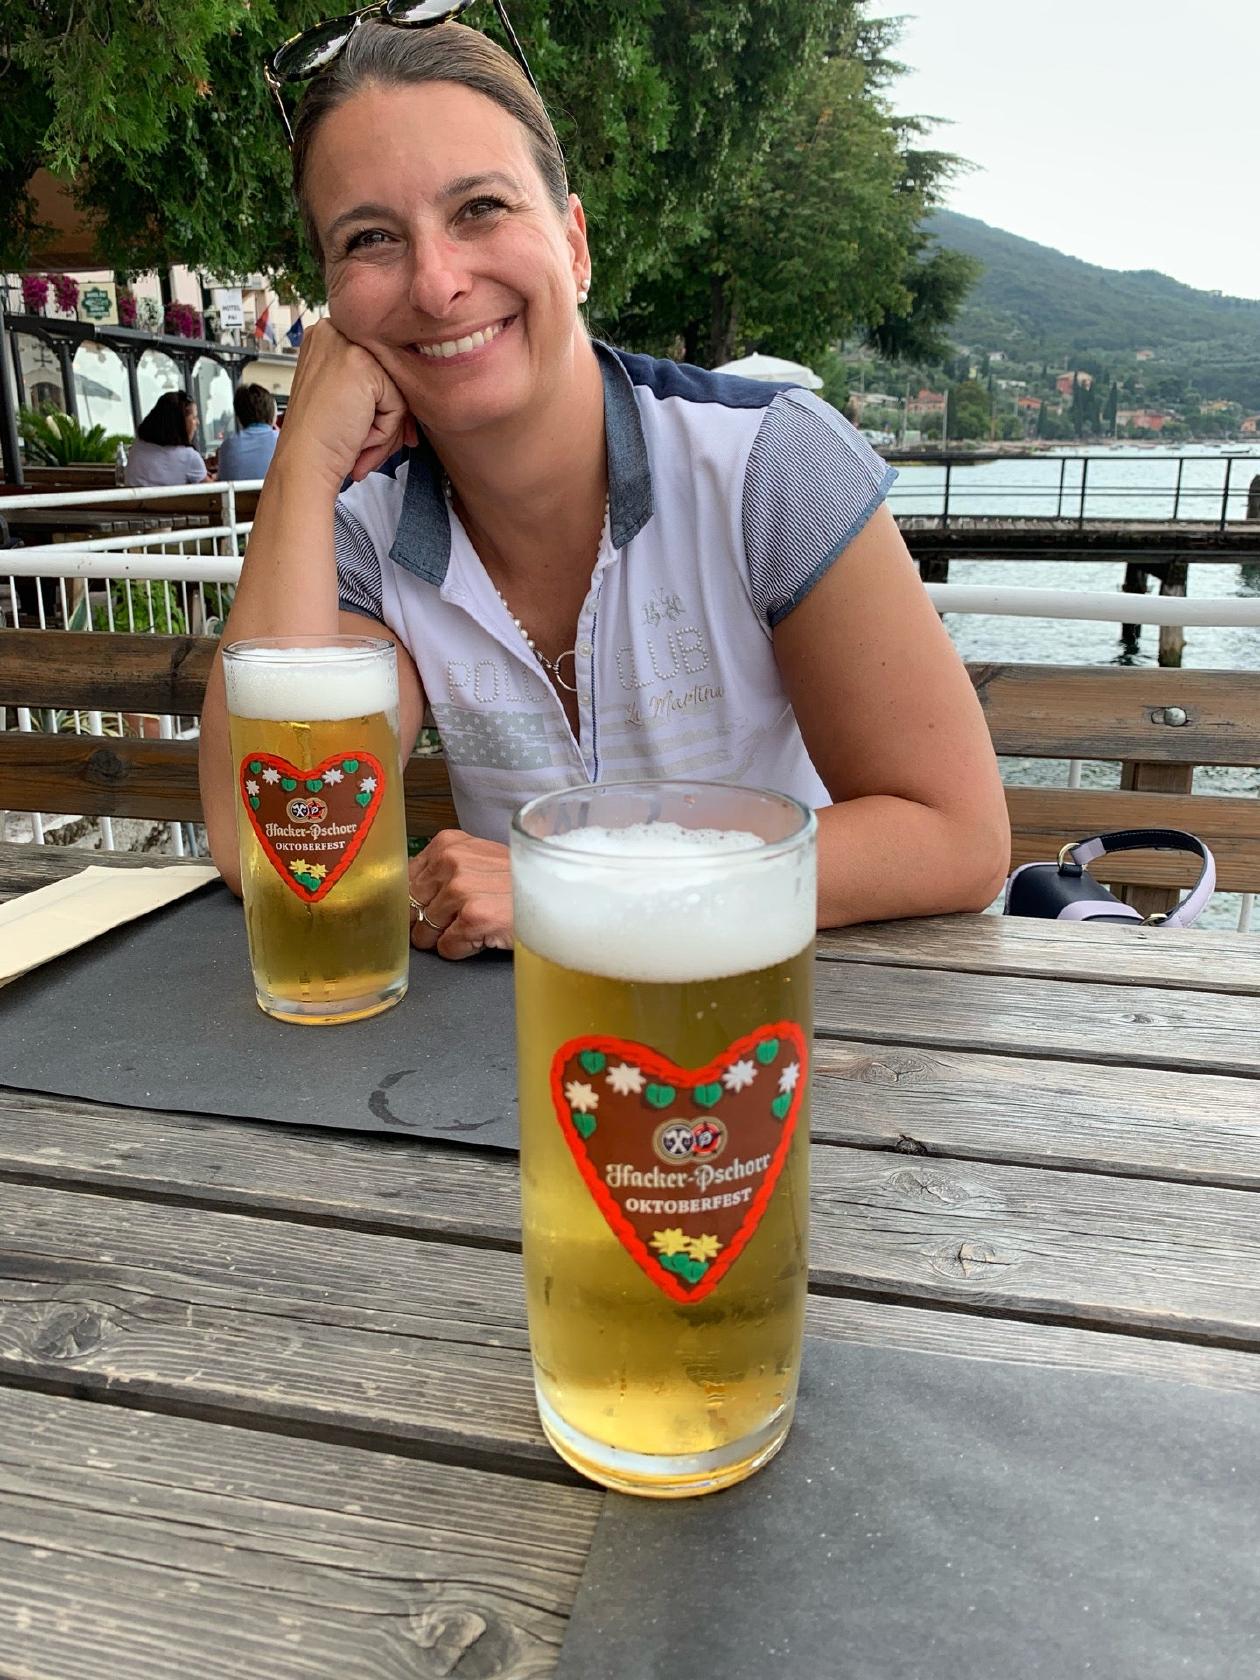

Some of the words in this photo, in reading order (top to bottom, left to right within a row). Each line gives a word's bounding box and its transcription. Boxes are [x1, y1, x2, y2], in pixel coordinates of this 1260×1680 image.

[265, 822, 358, 841] Hacker-Pschorr
[275, 841, 346, 851] OKTOBERFEST
[605, 1153, 771, 1193] Hacker-Pschorr
[625, 1187, 753, 1214] OKTOBERFEST
